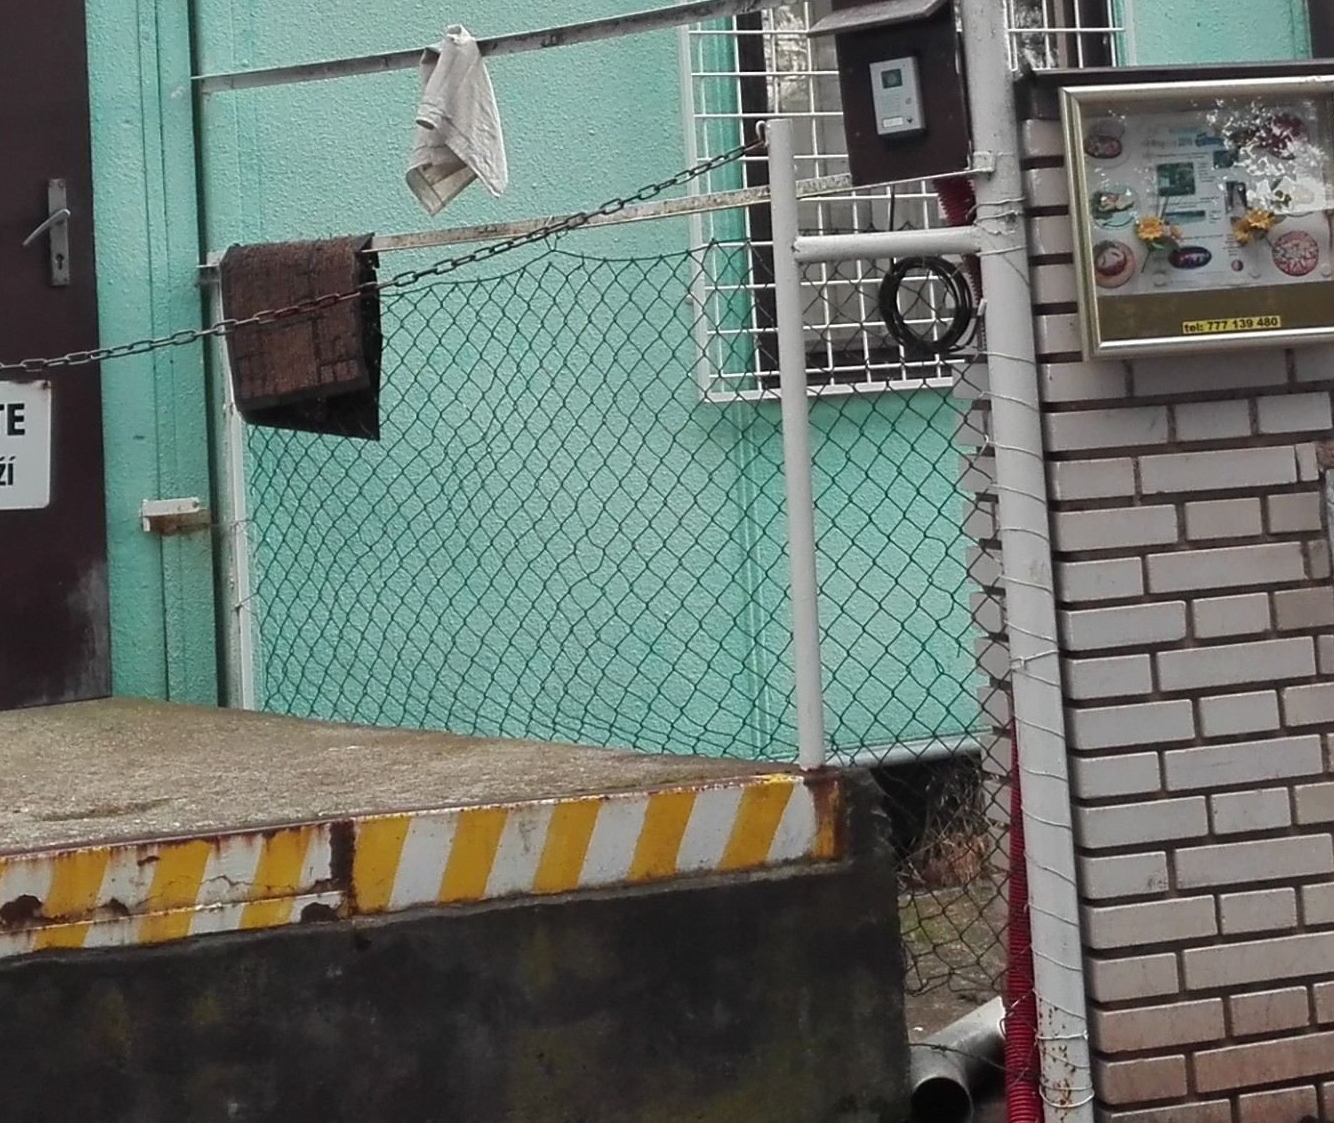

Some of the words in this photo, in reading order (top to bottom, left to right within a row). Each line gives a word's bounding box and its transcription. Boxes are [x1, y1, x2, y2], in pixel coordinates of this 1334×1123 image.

[1184, 323, 1204, 333] tel:
[1207, 320, 1228, 331] 777
[1232, 319, 1254, 329] 139
[1256, 317, 1279, 327] 480
